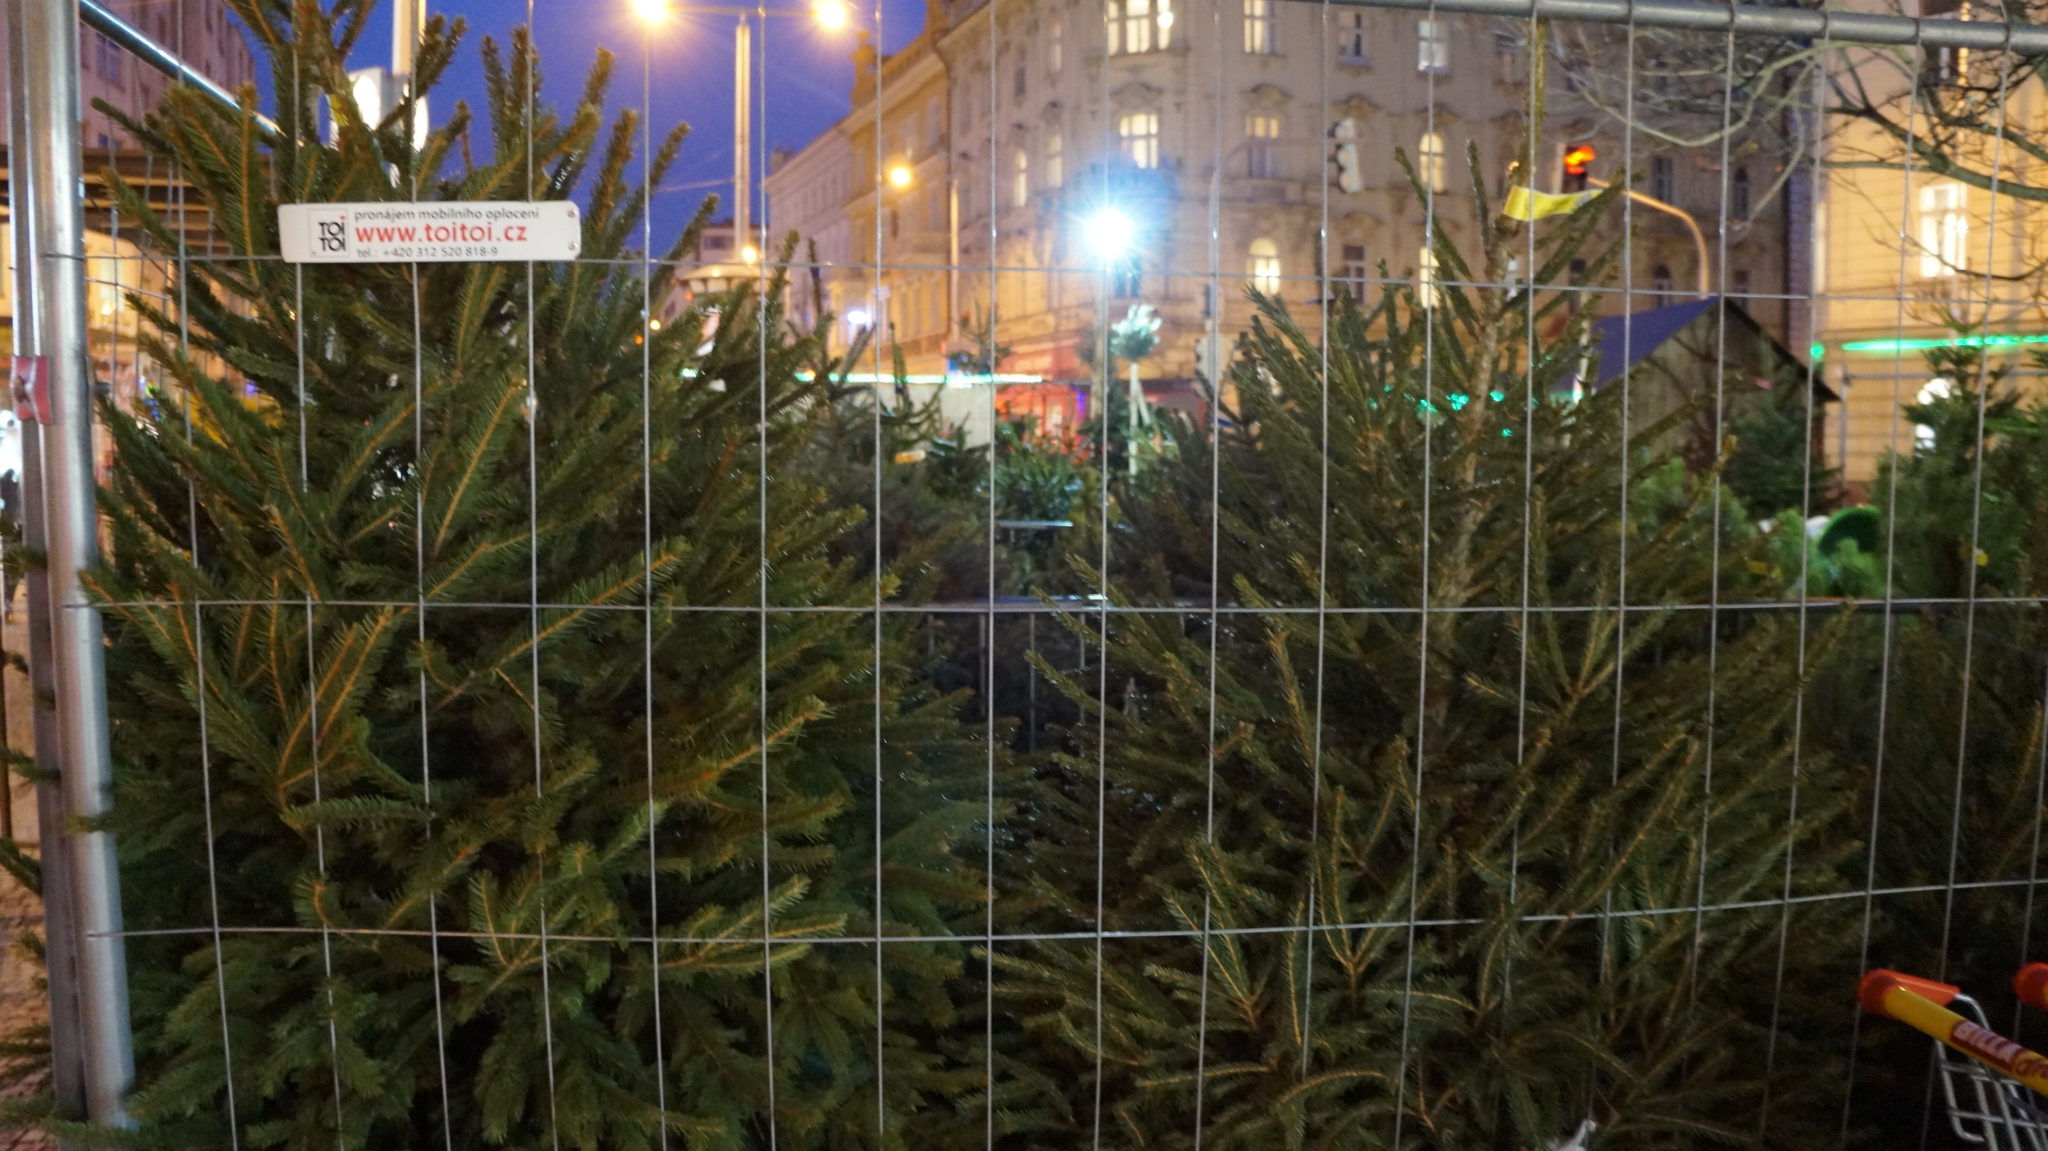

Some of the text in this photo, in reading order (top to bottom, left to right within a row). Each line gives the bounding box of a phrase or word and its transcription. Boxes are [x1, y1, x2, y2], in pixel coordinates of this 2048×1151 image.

[354, 207, 540, 222] pronájem mobilního oplocení
[355, 222, 528, 242] www.toitoi.cz
[319, 237, 346, 251] TOI
[383, 247, 412, 257] +420
[417, 247, 438, 257] 312
[441, 246, 462, 257] 520
[465, 246, 498, 256] 818-9
